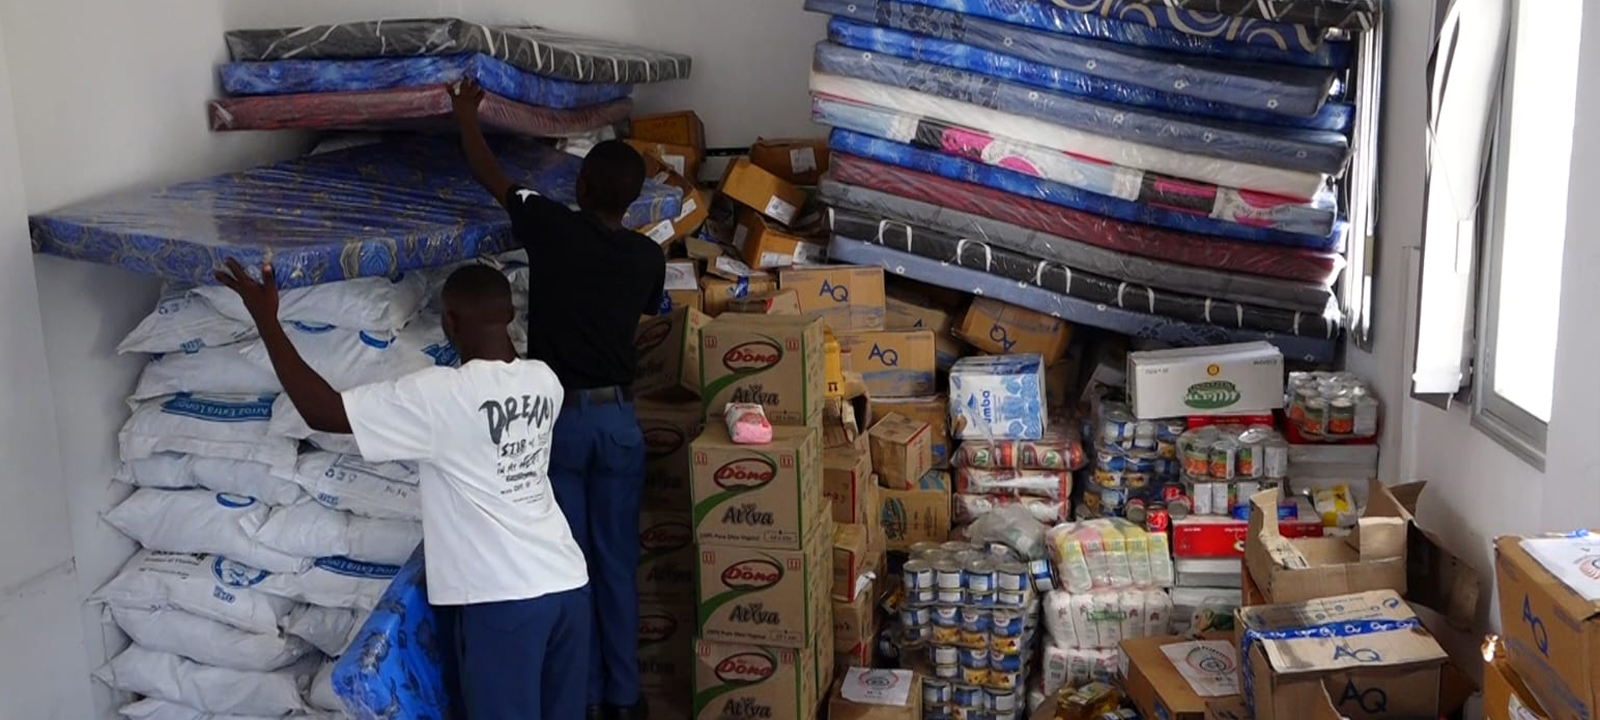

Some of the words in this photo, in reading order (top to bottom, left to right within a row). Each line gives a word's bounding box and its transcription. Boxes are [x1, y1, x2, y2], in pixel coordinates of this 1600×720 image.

[819, 279, 849, 303] AQ
[868, 342, 899, 367] AQ
[1522, 592, 1550, 659] AQ
[1333, 645, 1382, 663] AQ
[1338, 679, 1388, 715] AQ
